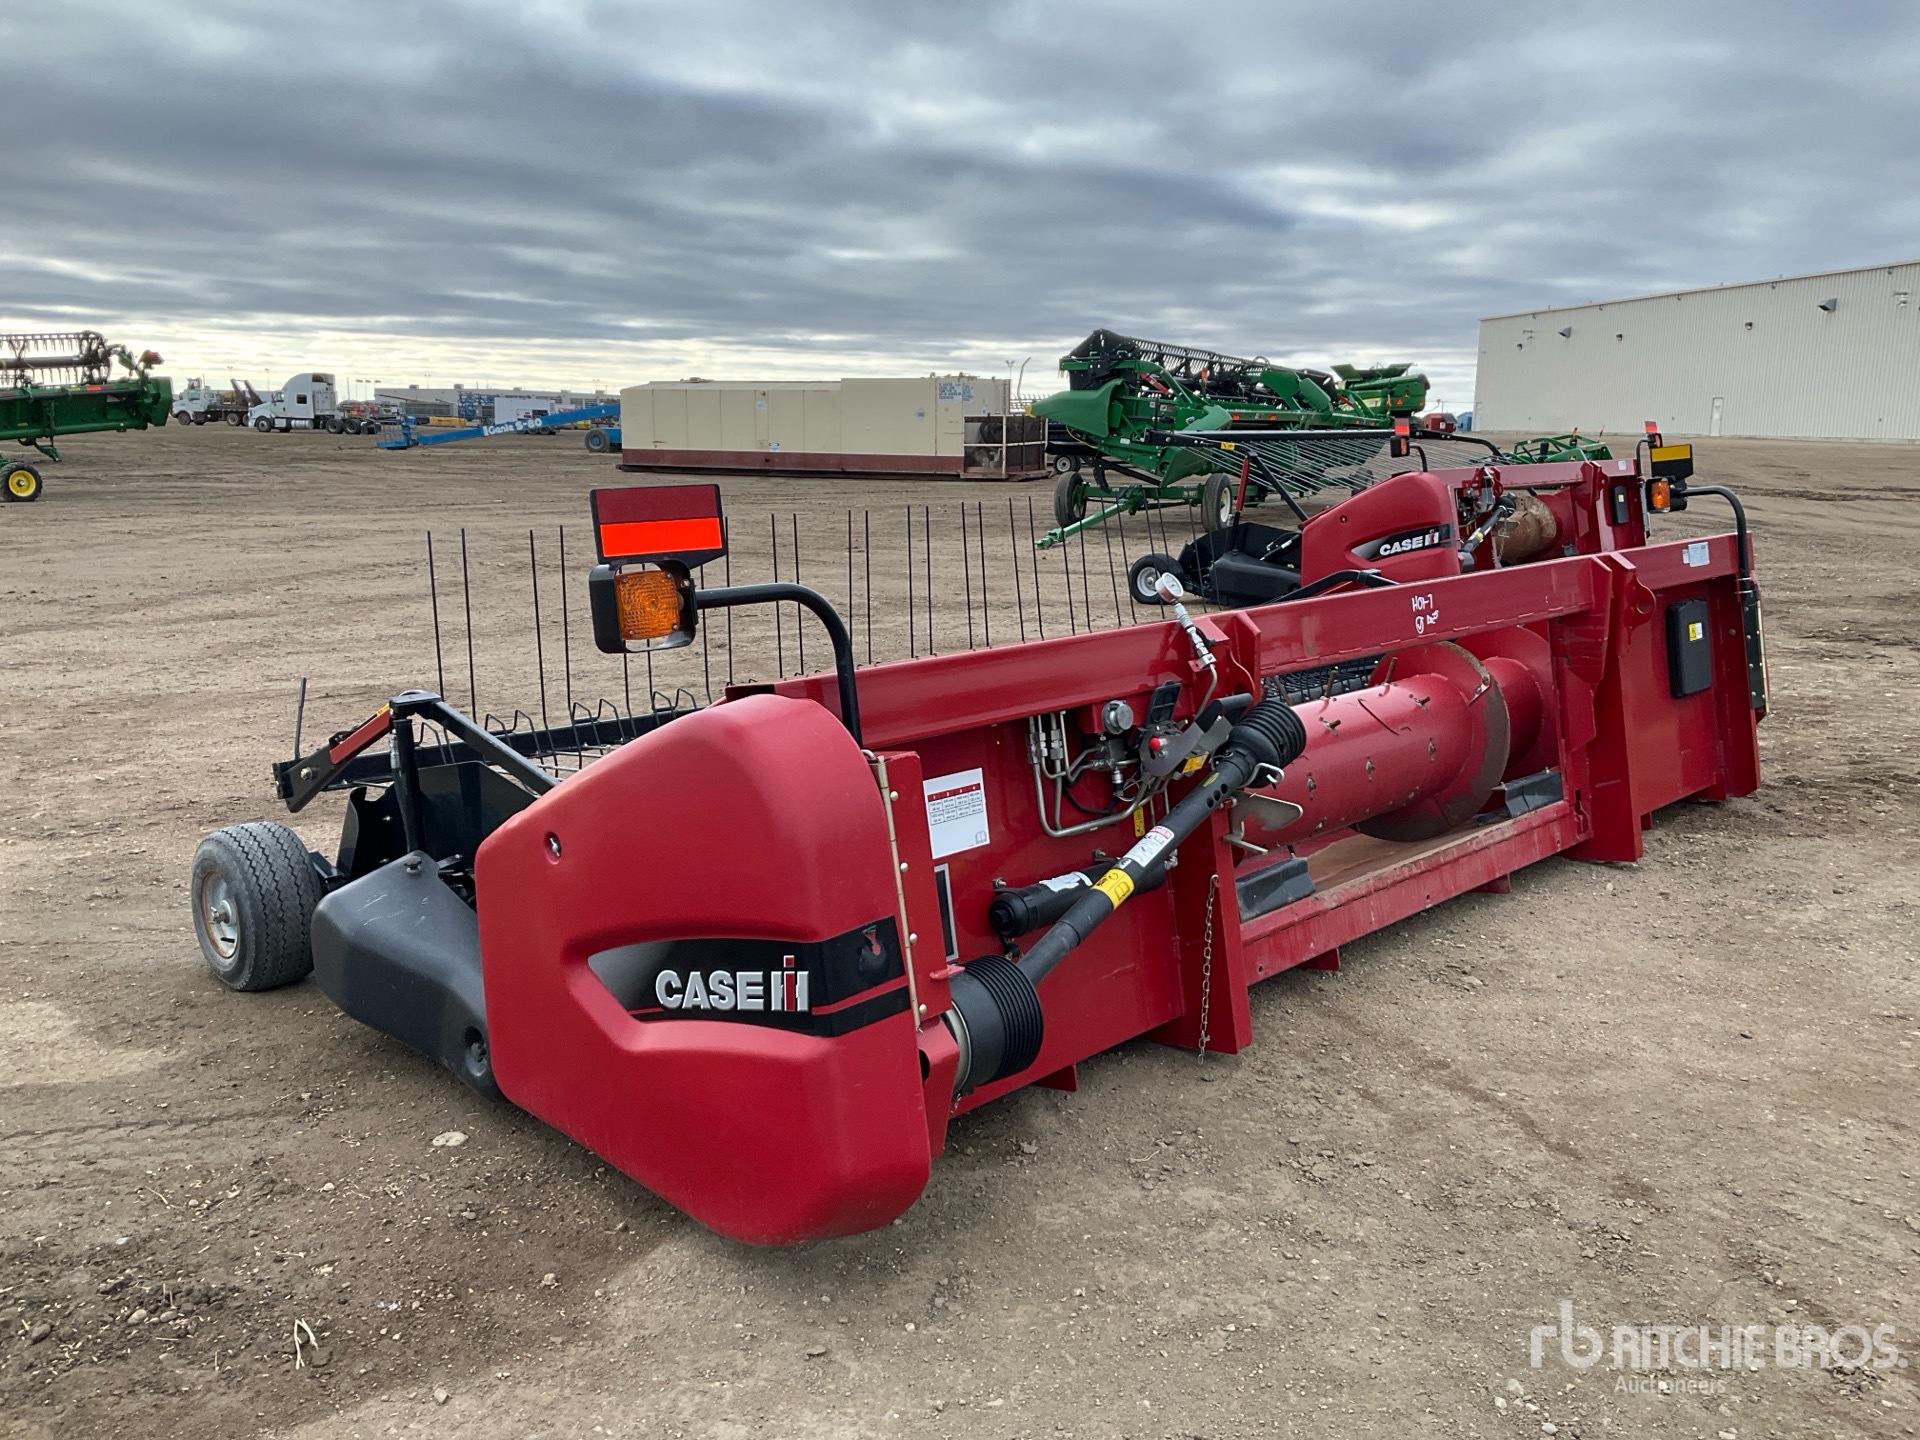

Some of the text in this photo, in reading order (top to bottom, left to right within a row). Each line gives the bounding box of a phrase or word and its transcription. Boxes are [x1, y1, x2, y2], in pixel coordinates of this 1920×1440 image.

[488, 418, 543, 435] Genie S-80
[1380, 535, 1424, 556] CASE
[655, 969, 765, 1012] CASE
